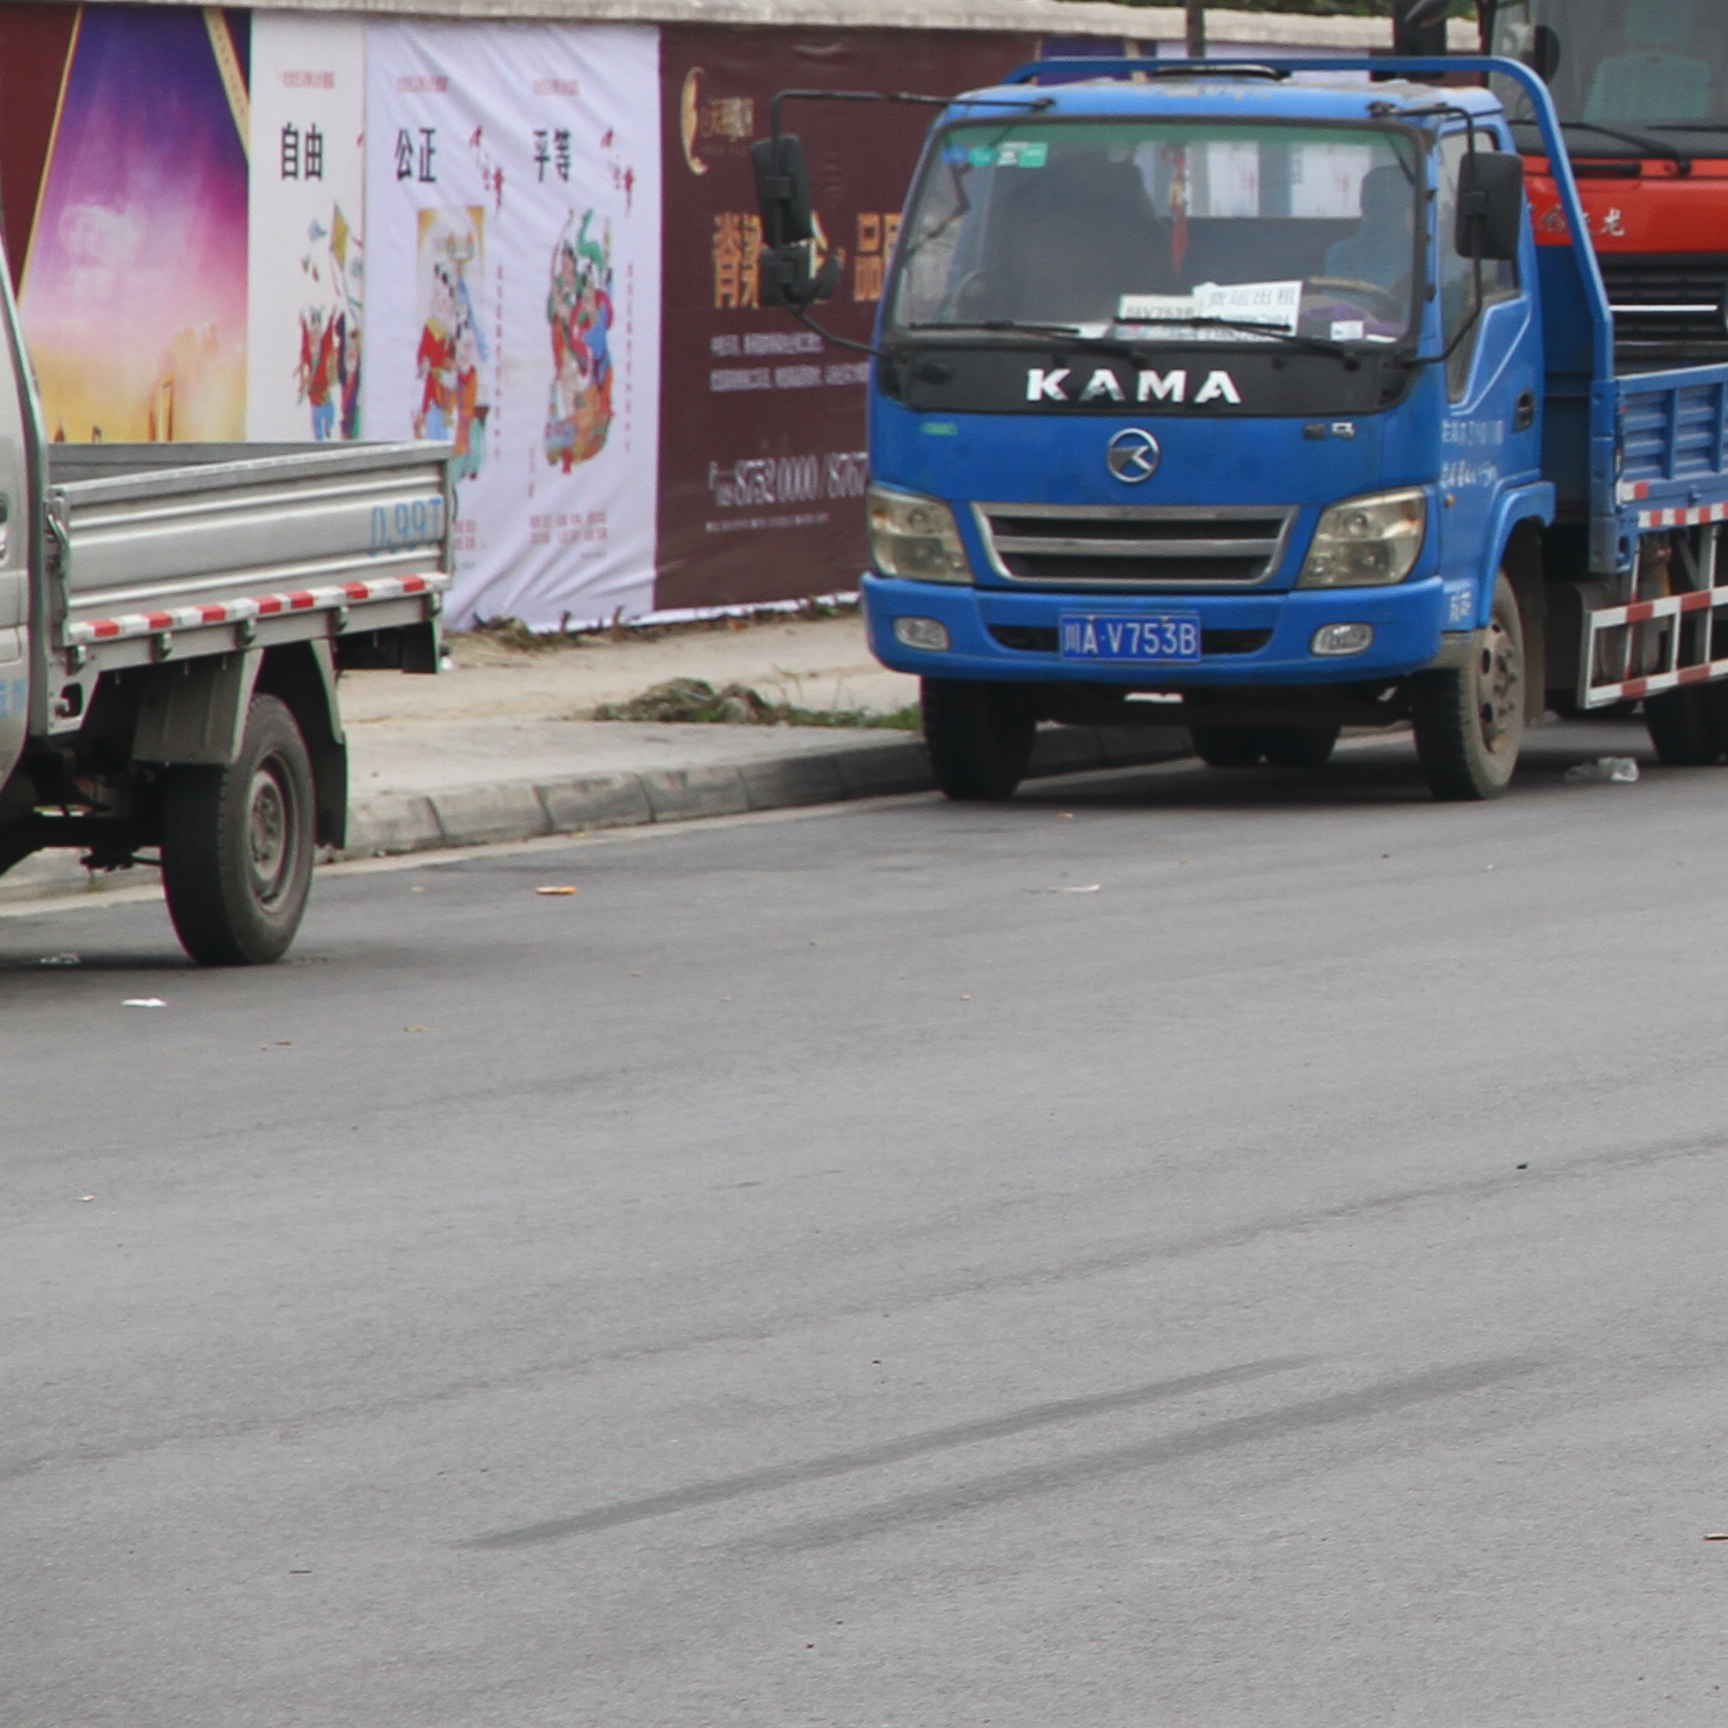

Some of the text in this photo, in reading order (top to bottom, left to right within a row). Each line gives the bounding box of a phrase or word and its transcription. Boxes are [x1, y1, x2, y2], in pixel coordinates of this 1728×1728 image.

[281, 121, 323, 181] 自由
[394, 128, 437, 183] 公正
[532, 128, 571, 183] 平等
[1026, 368, 1242, 404] KAMA
